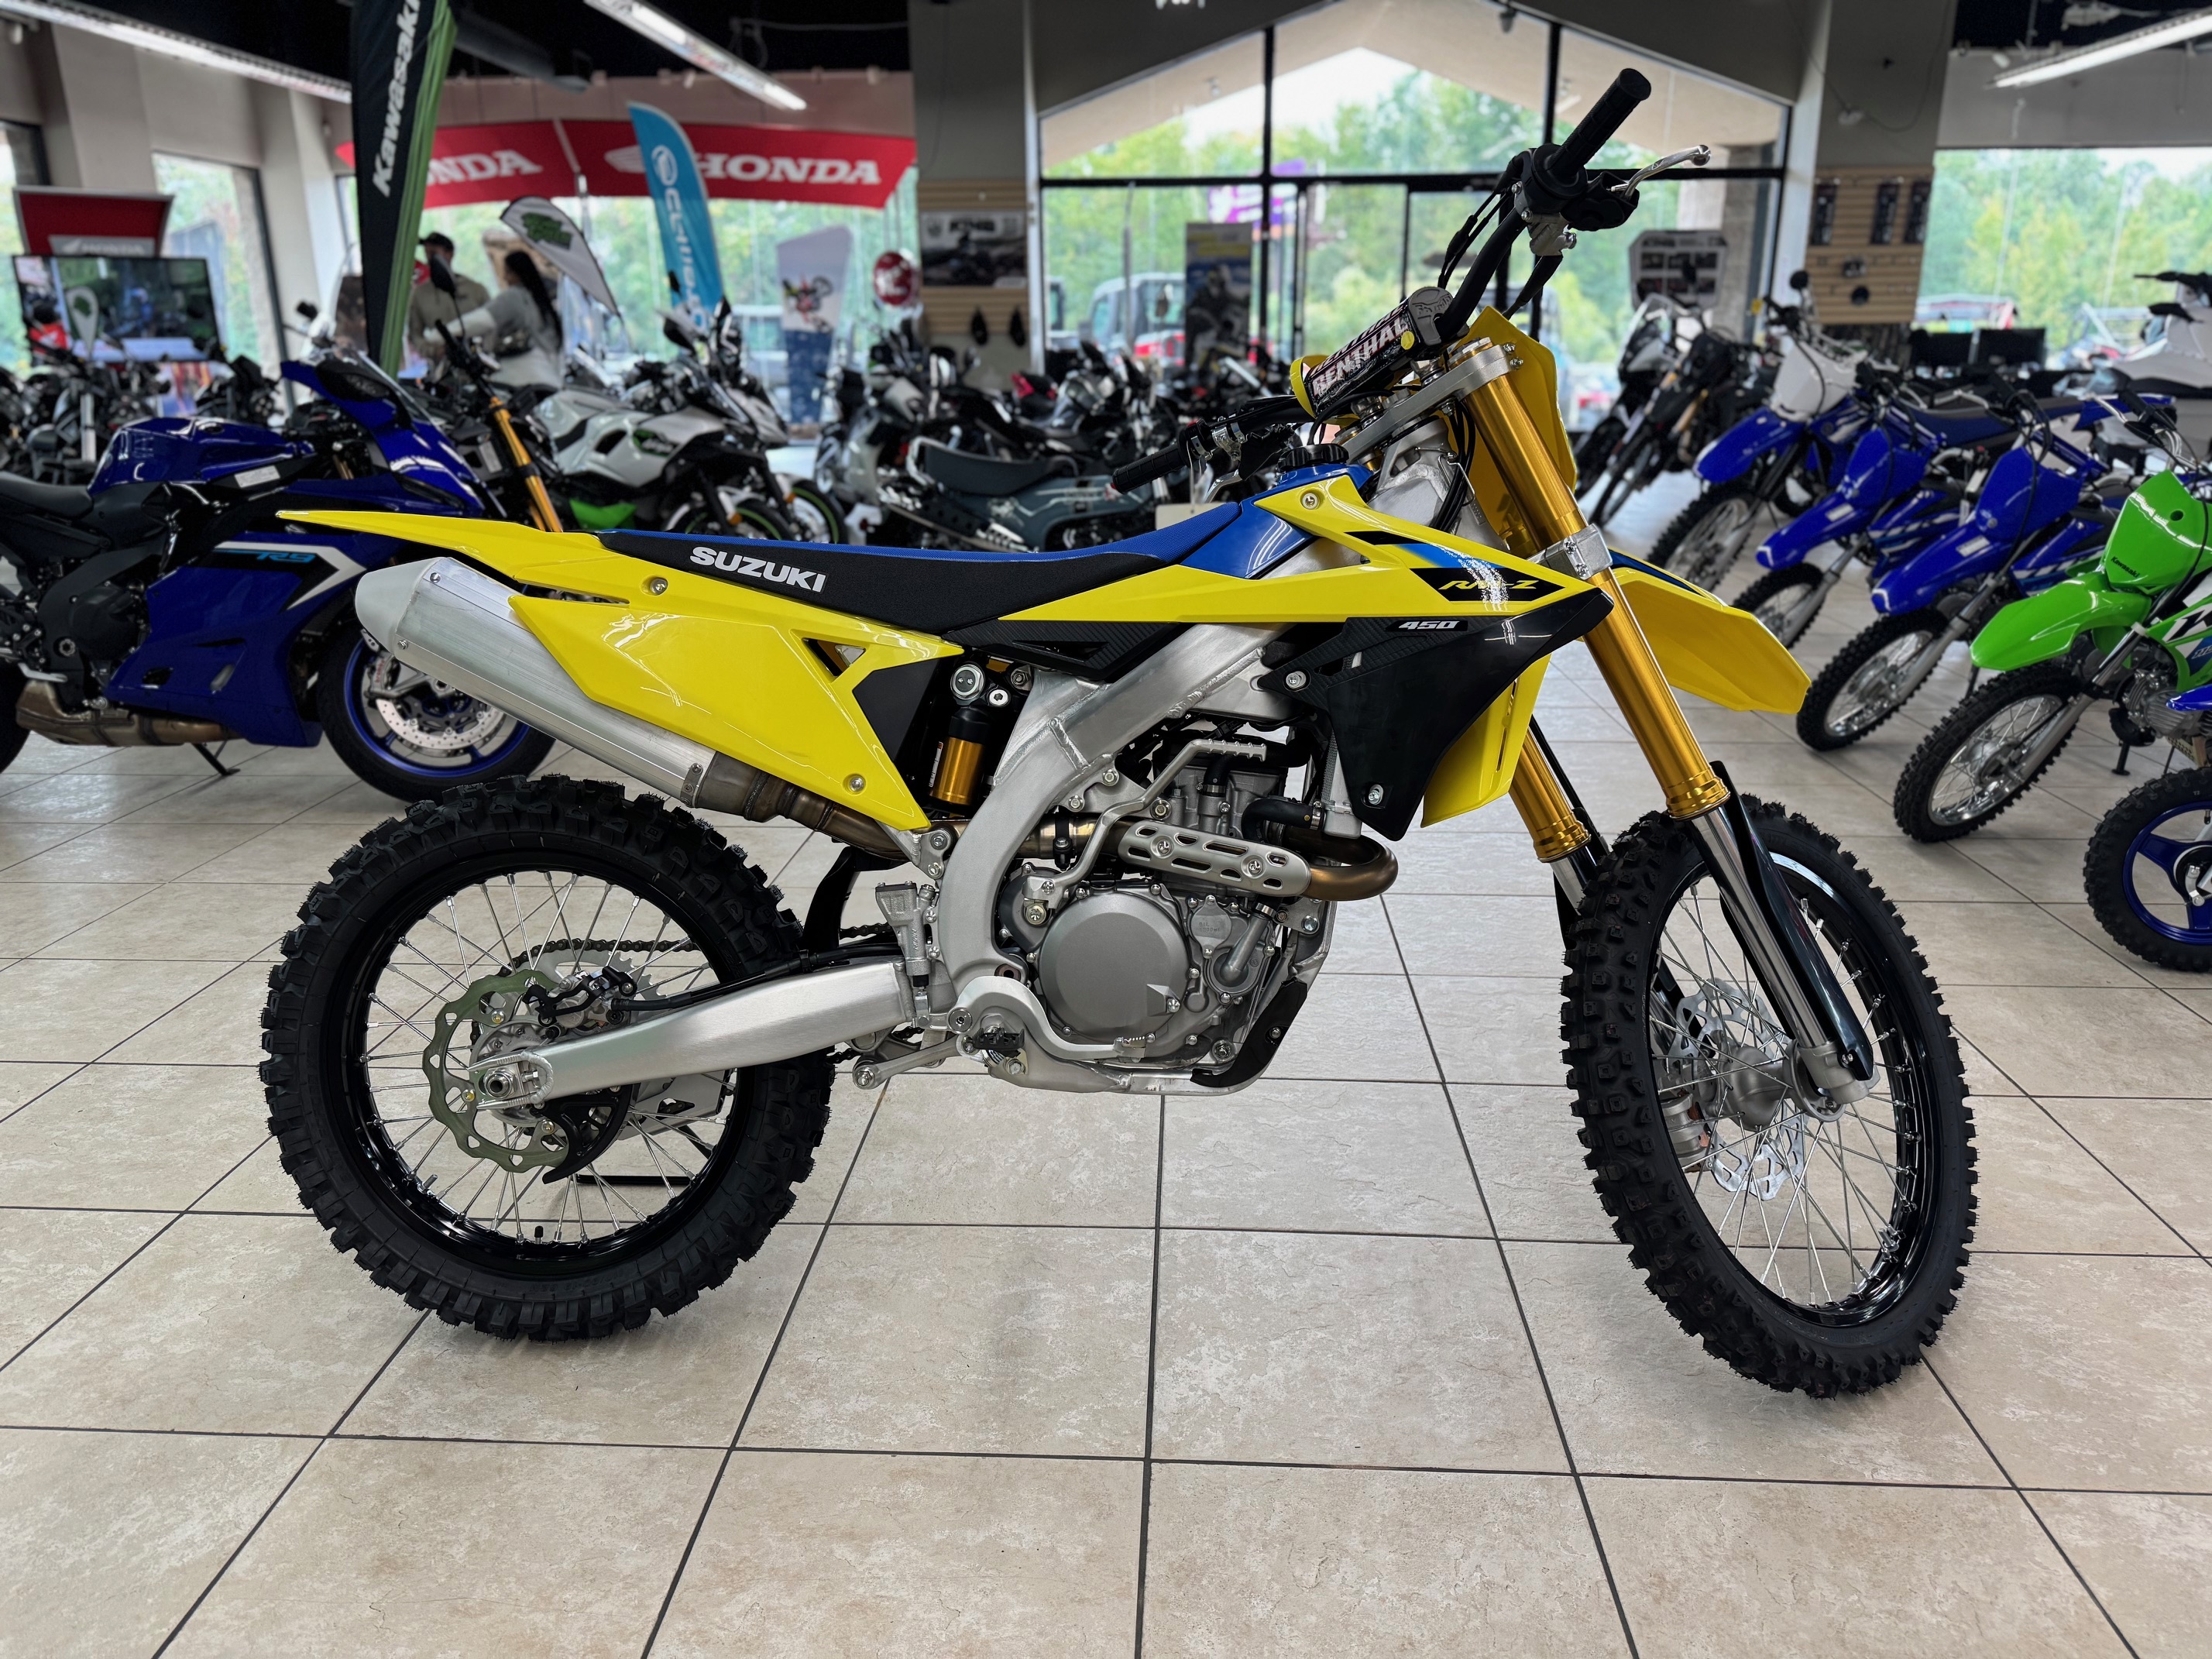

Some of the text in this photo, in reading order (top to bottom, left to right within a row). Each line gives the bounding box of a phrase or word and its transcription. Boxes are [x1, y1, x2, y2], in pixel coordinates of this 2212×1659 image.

[373, 0, 421, 198] Kawasaki
[696, 152, 882, 185] HONDA
[1311, 315, 1411, 397] RENTHAL
[256, 551, 316, 564] R9
[689, 545, 826, 593] SUZUKI
[2110, 555, 2141, 579] Kawasaki
[1398, 620, 1460, 630] 450
